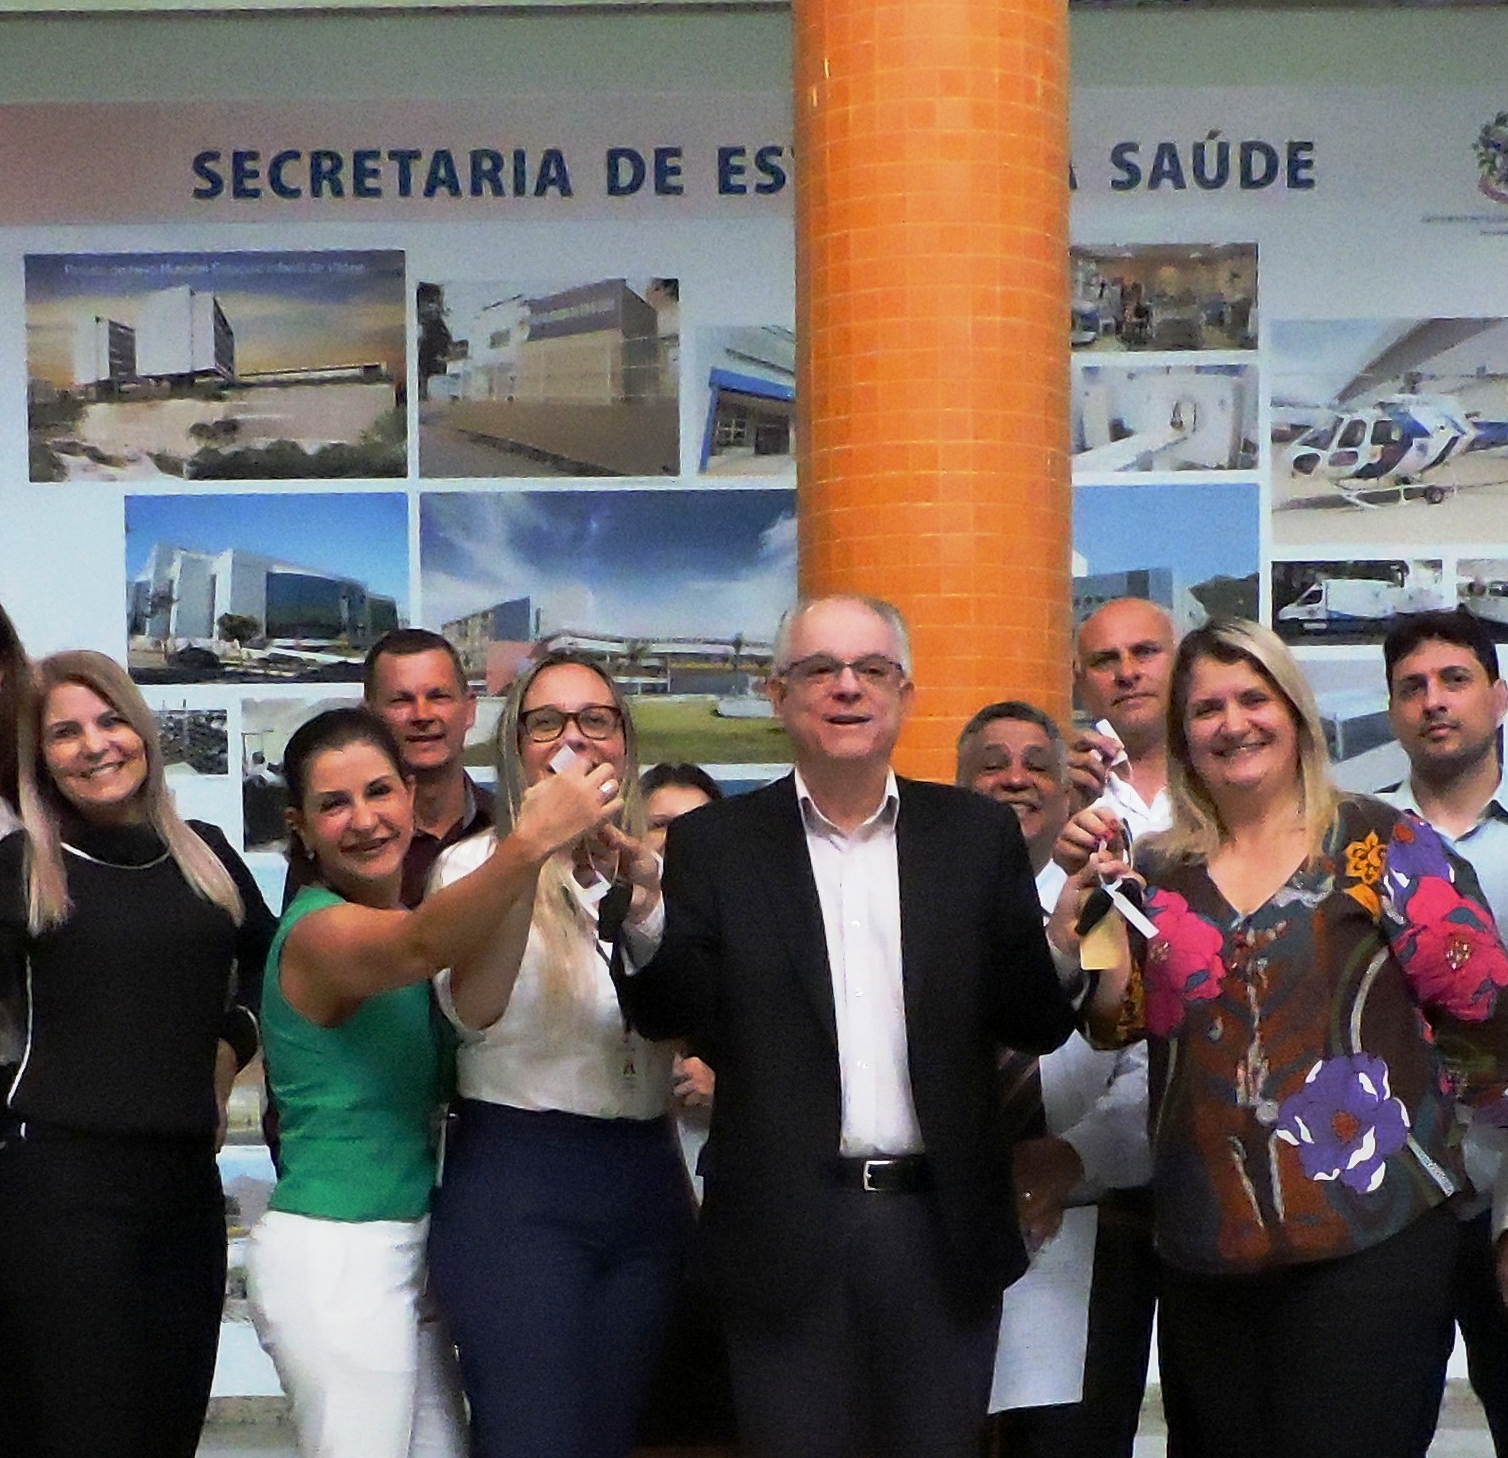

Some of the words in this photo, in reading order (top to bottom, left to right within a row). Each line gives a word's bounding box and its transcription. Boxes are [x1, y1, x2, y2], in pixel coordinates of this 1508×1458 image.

[192, 148, 574, 199] SECRETARIA
[606, 147, 684, 196] DE
[717, 145, 794, 196] ES
[1109, 129, 1316, 191] SAÚDE
